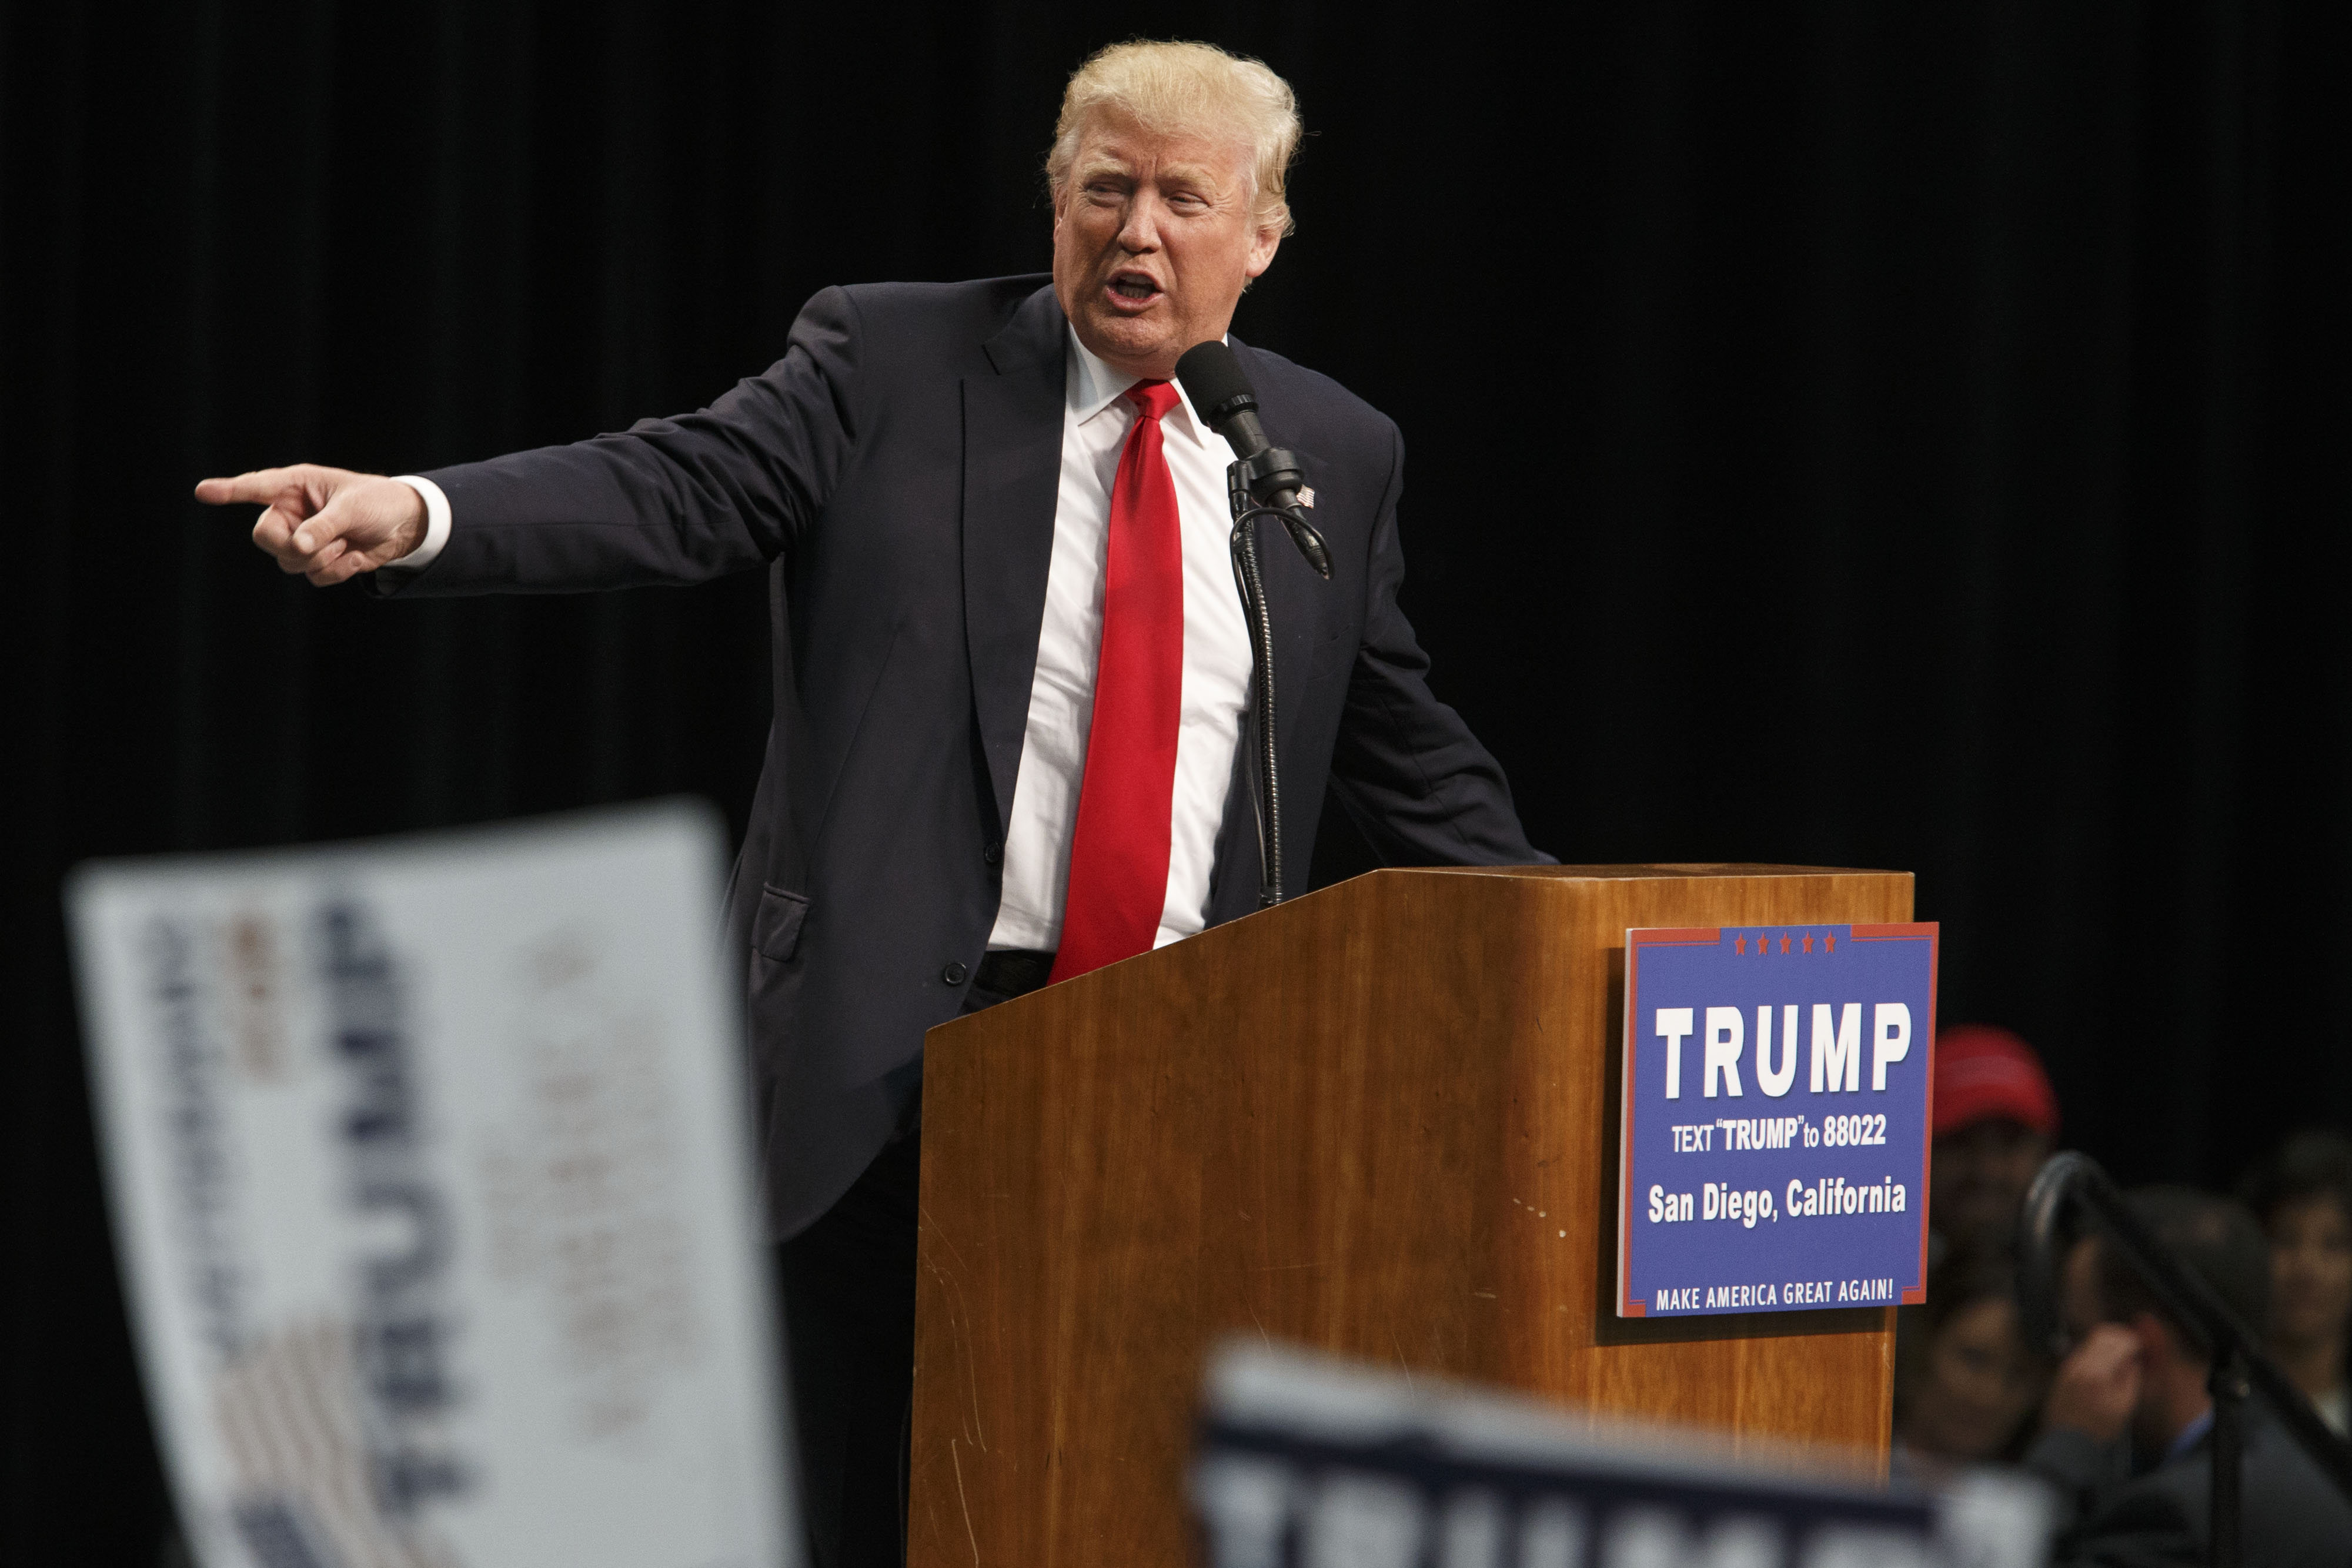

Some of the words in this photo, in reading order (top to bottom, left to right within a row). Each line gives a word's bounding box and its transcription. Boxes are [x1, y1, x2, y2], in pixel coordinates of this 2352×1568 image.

[1656, 1003, 1912, 1099] TRUMP
[1672, 1125, 1715, 1152] TEXT
[1803, 1122, 1819, 1148] to
[1823, 1114, 1886, 1147] 88022
[309, 889, 479, 1512] TRUMP
[1649, 1185, 1693, 1223] San
[1703, 1183, 1778, 1229] Diego,
[1787, 1176, 1906, 1217] California
[1656, 1288, 1700, 1311] MAKE
[1706, 1284, 1777, 1308] AMERICA
[1784, 1282, 1833, 1304] GREAT
[1838, 1279, 1893, 1302] AGAIN!
